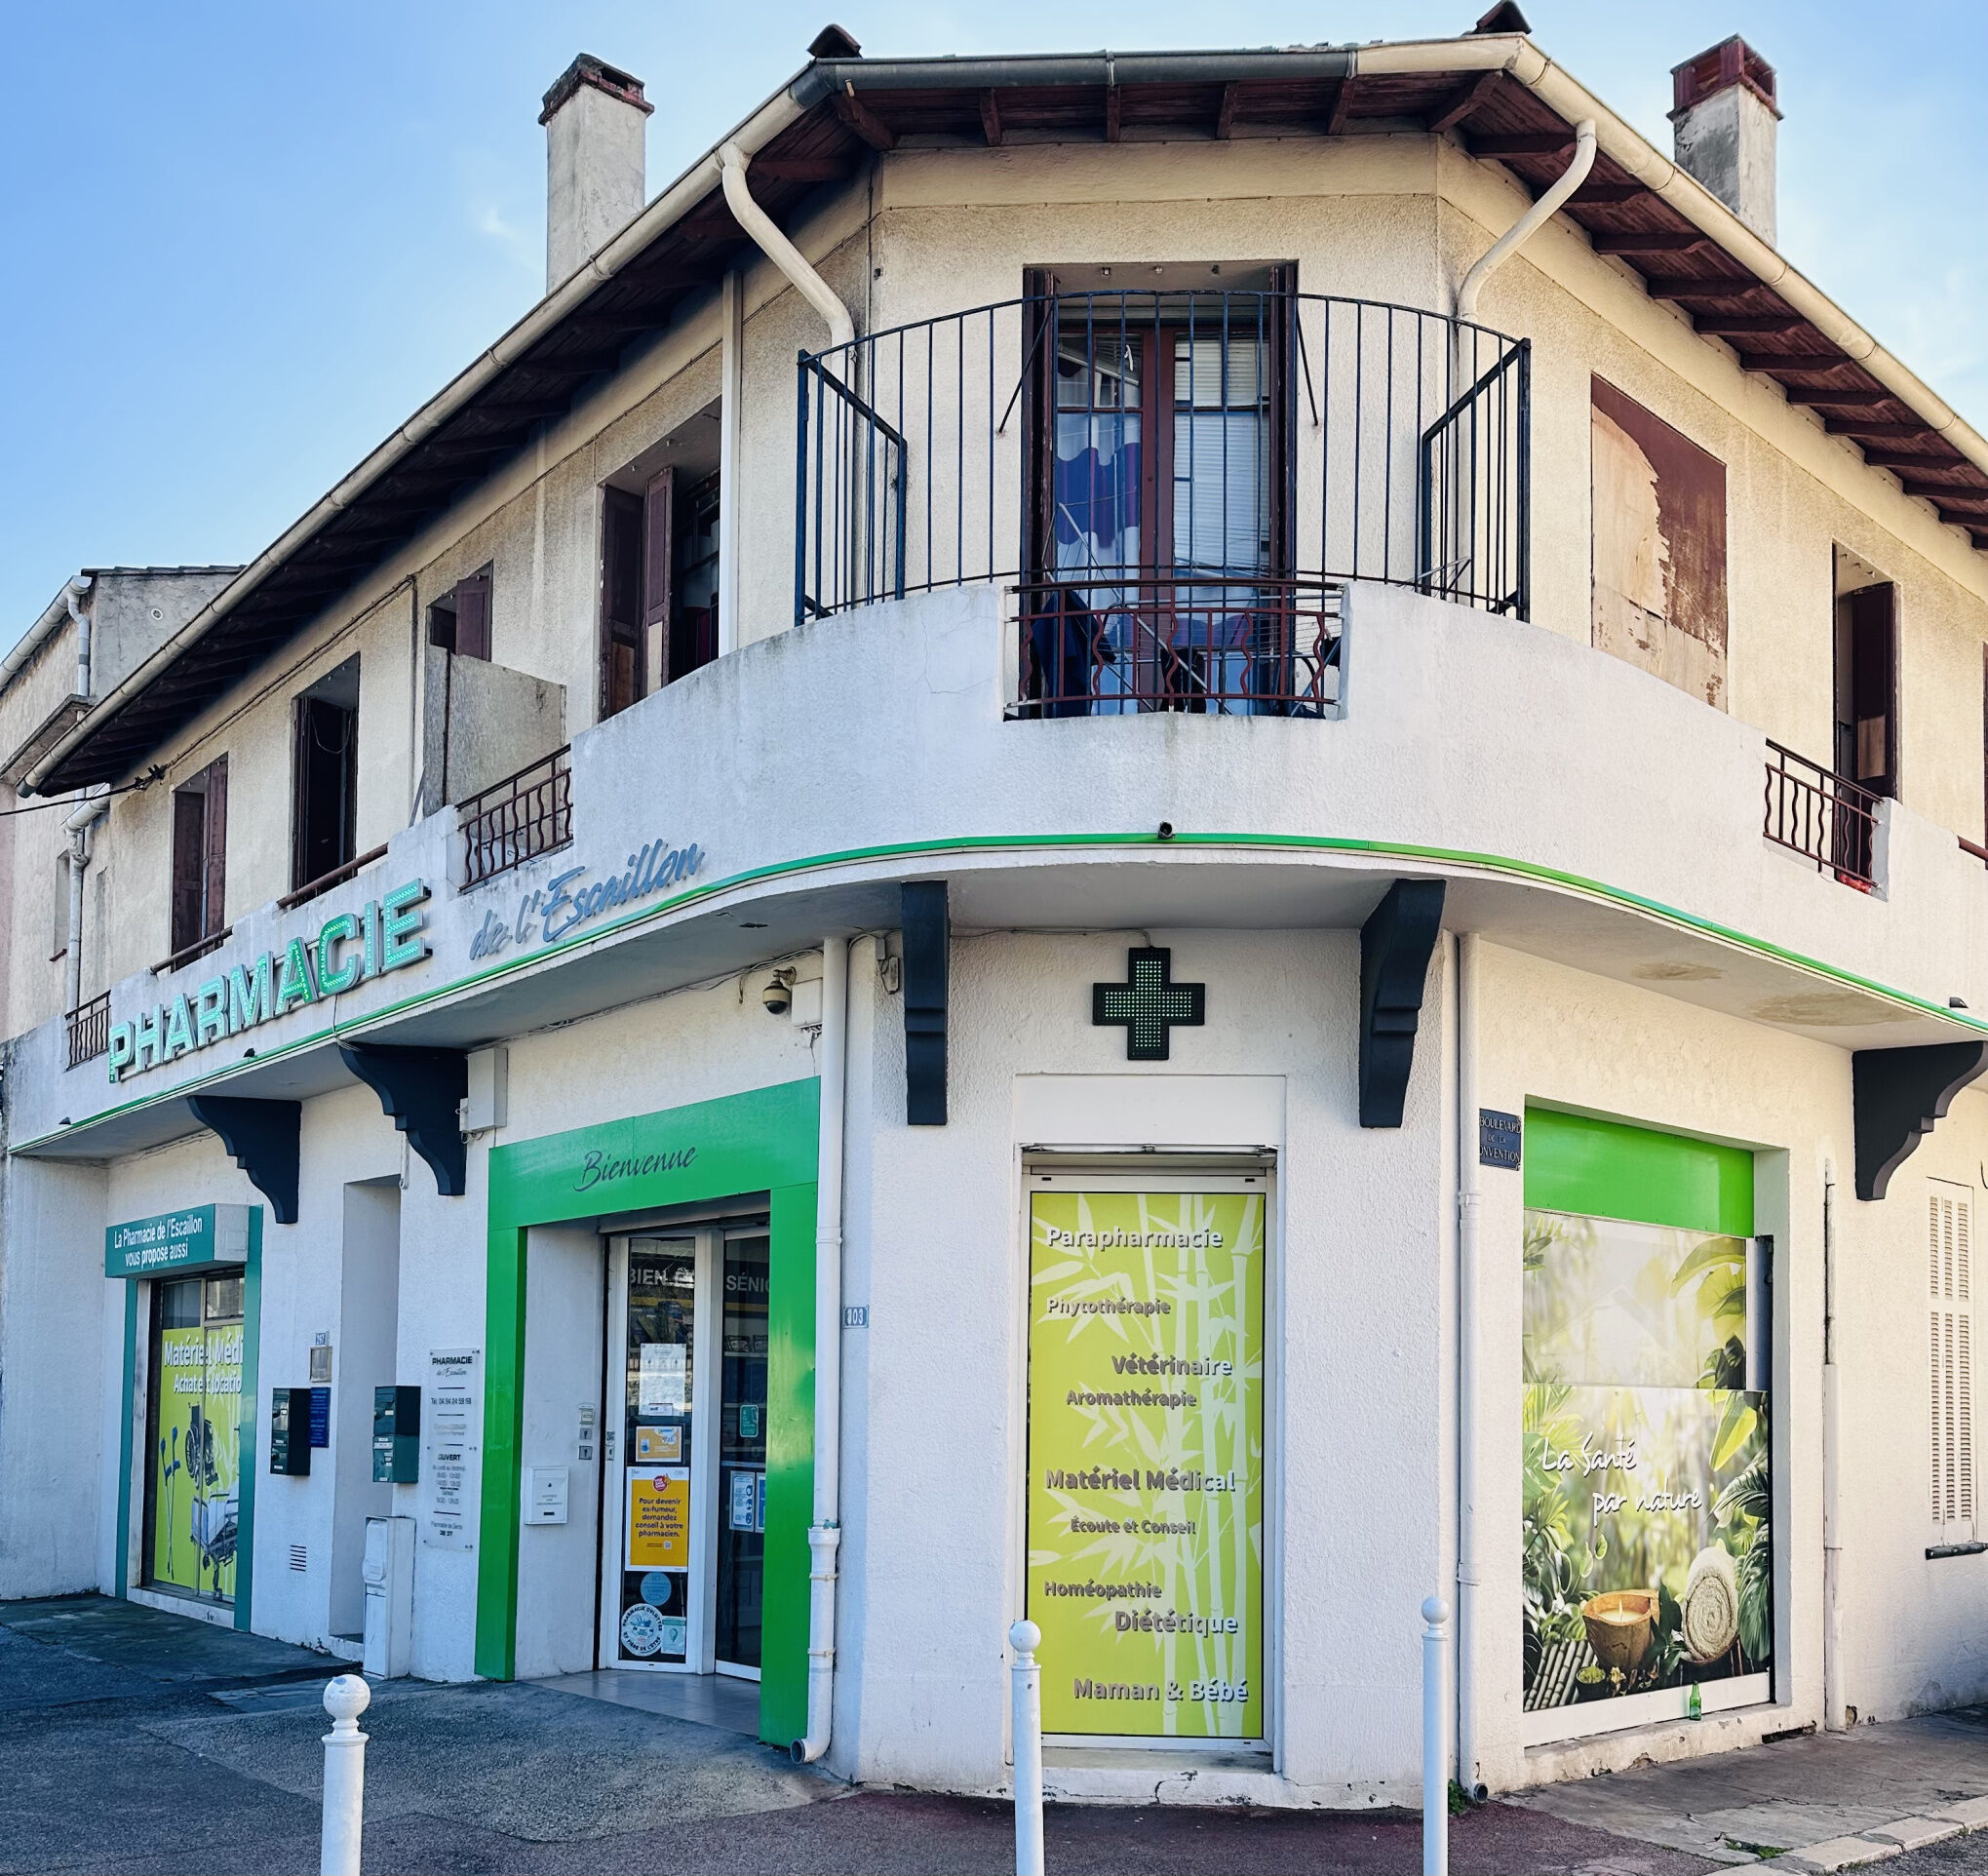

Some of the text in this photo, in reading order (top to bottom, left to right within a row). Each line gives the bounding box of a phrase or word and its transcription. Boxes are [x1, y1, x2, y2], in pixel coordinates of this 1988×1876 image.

[469, 839, 705, 960] de l'Escaillon
[108, 878, 432, 1083] PHARMACIE
[573, 1147, 698, 1192] Bienvenue
[114, 1214, 203, 1248] La Pharmacie de l'Escaillon
[1046, 1226, 1224, 1252] Parapharmacie
[125, 1238, 188, 1269] vous propose aussi
[1047, 1297, 1171, 1317] Phytothérapie
[164, 1334, 213, 1367] Matériel
[432, 1356, 472, 1365] PHARMACIE
[1111, 1352, 1232, 1375] Vétérinaire
[174, 1373, 197, 1393] Achat
[1067, 1388, 1197, 1410] Aromathérapie
[1542, 1431, 1638, 1478] La Santé
[1045, 1466, 1236, 1492] Matériel Médical
[1593, 1476, 1703, 1527] par nature
[639, 1530, 680, 1539] pharmacien.
[1071, 1515, 1196, 1535] Écoute et Conseil
[1044, 1580, 1162, 1600] Homéopathie
[1115, 1608, 1238, 1638] Diététique
[1073, 1677, 1249, 1702] Maman & Bébé
